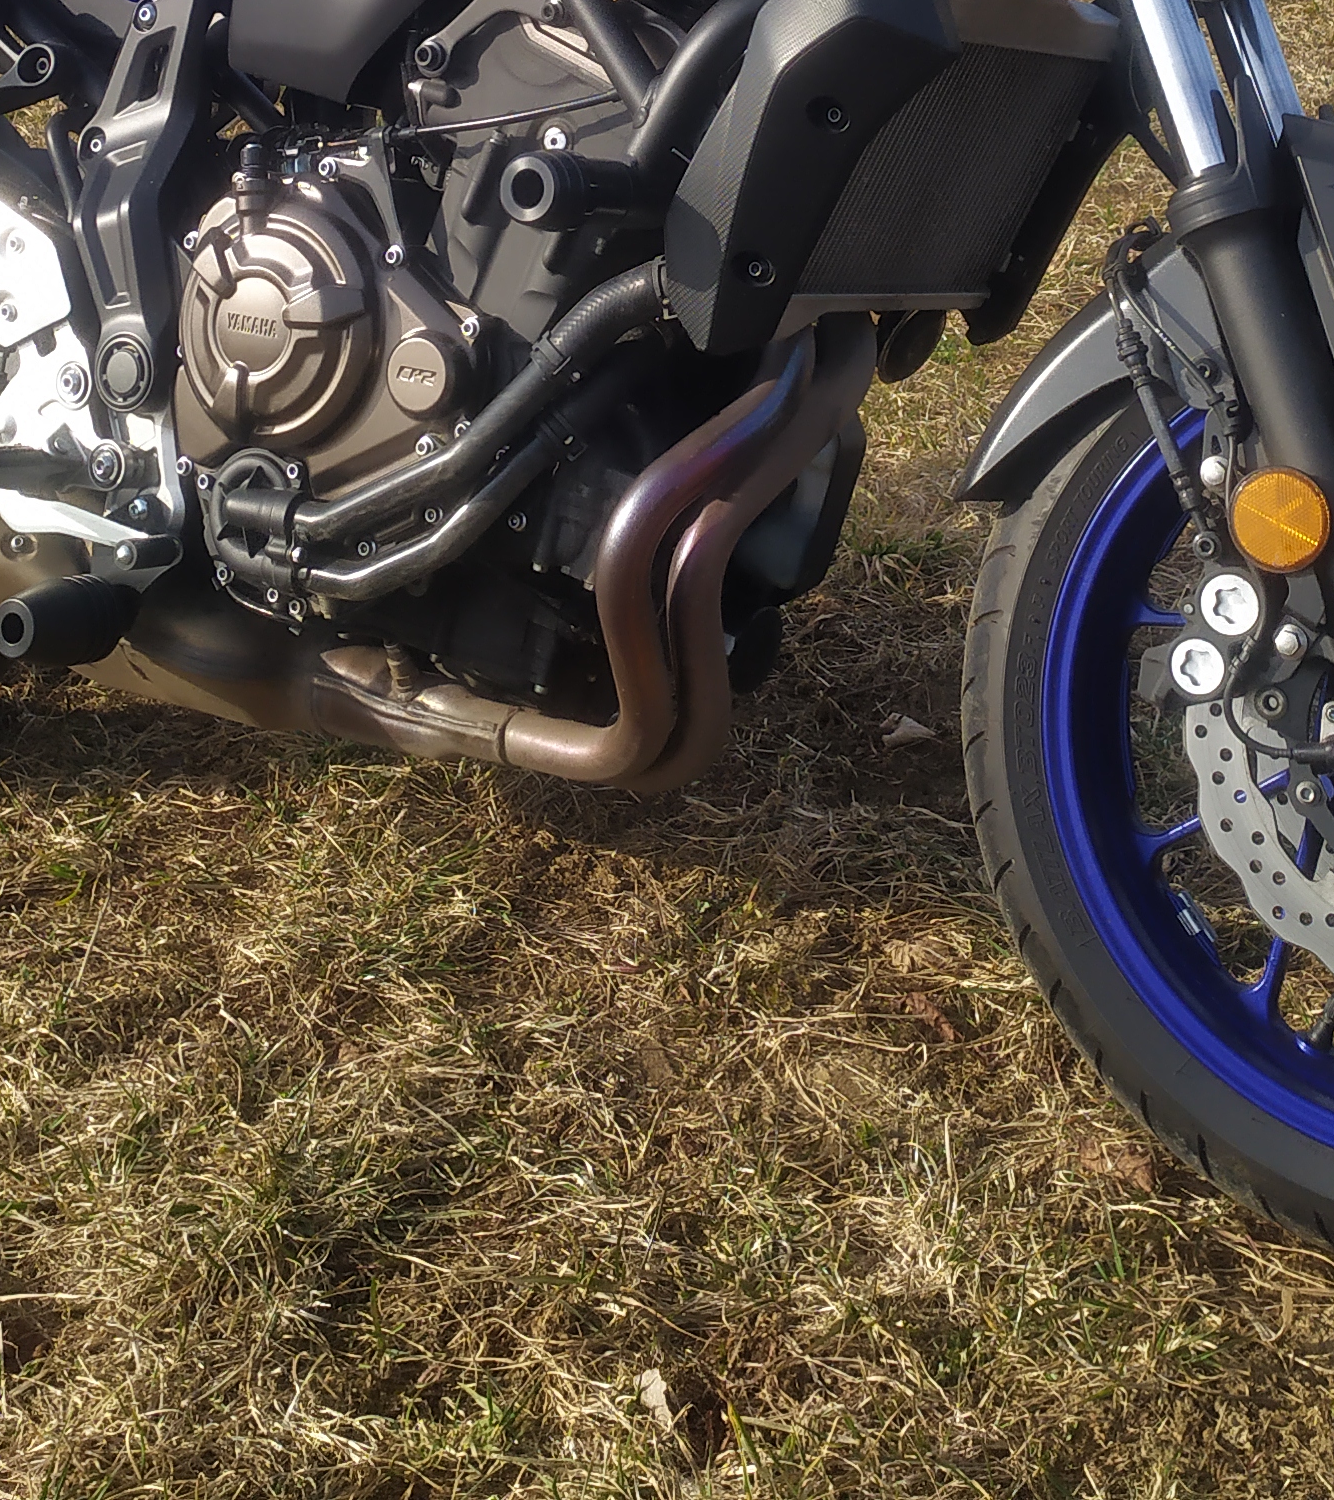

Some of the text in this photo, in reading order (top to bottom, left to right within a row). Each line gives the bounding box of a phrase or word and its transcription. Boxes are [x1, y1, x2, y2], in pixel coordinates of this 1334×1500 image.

[226, 311, 278, 339] YAMAHA
[395, 364, 438, 388] CP2
[1045, 434, 1129, 570] SPORT TOURING
[1020, 784, 1088, 938] BATTLAX
